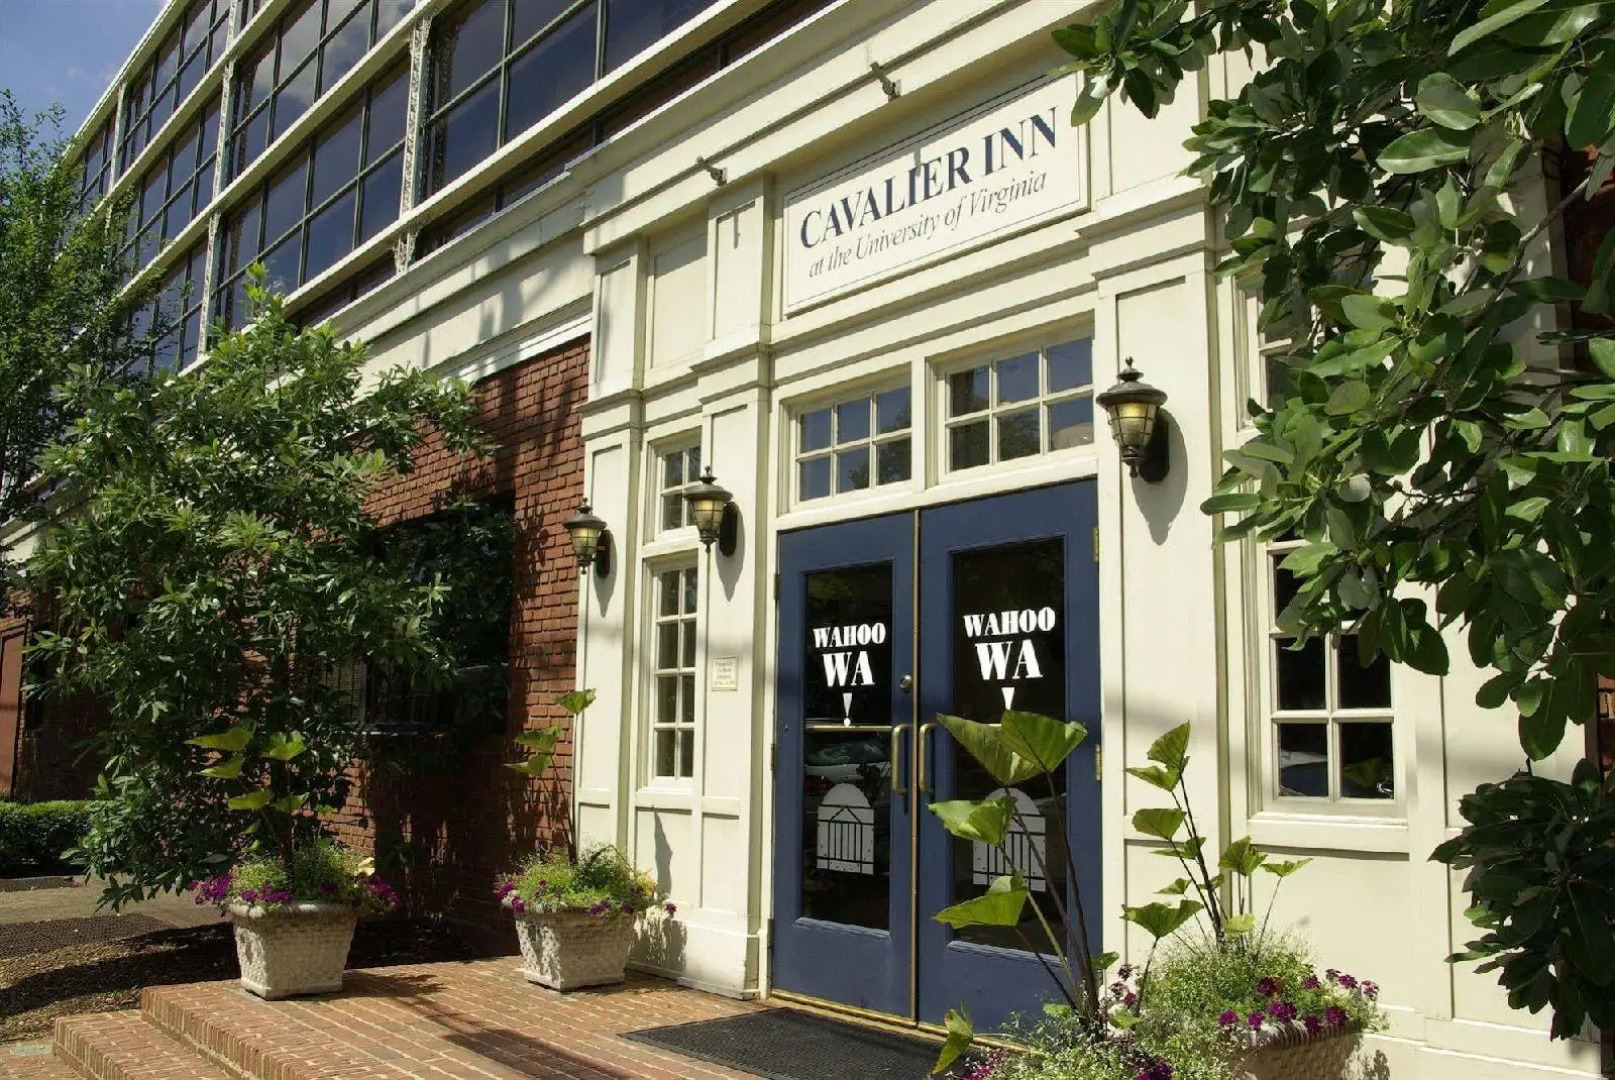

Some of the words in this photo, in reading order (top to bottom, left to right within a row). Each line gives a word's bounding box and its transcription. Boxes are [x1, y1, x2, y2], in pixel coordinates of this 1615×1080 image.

[801, 146, 973, 249] CAVALIER
[983, 106, 1057, 176] INN
[809, 257, 823, 278] at
[827, 246, 851, 270] the
[856, 213, 941, 261] University
[944, 195, 966, 232] of
[970, 170, 1047, 214] Virginia
[813, 622, 887, 648] WAHOO
[963, 606, 1056, 638] WAHOO
[822, 650, 875, 687] WA
[975, 639, 1043, 681] WA
